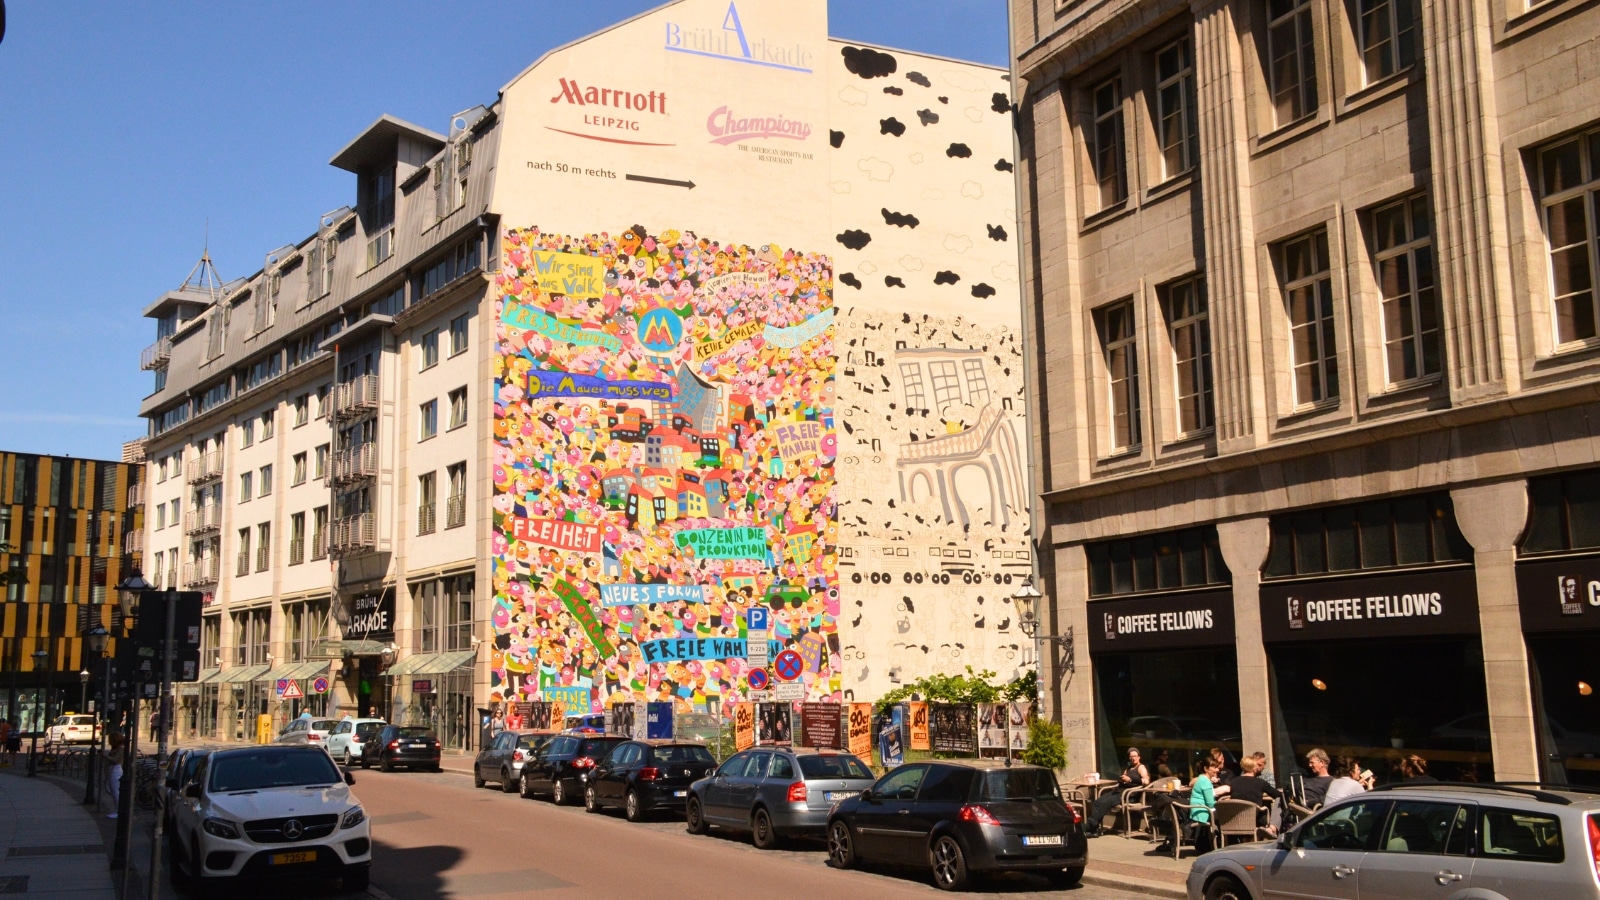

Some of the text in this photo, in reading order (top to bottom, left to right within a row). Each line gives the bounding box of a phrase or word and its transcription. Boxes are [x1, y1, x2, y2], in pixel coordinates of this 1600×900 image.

[665, 0, 813, 68] Brühl Arkade
[550, 77, 667, 115] Marriott
[584, 114, 640, 131] LEIPZIG
[707, 105, 811, 139] Champions
[737, 144, 749, 152] THE
[751, 146, 779, 156] AMERICAN
[780, 150, 801, 158] SPORTS
[759, 155, 793, 165] RESTAURANT
[527, 160, 617, 179] nach 50 m rechts
[534, 252, 564, 275] Wir
[540, 278, 558, 291] das
[696, 323, 757, 358] KEINE GEWALT
[529, 375, 670, 399] Die Mauer muss weg
[776, 423, 820, 444] FREIE
[513, 519, 598, 548] FREIHEIT
[677, 529, 763, 547] BONZEN IN DIE
[356, 594, 378, 610] BRÜHL
[603, 585, 701, 604] NEUES FORUM
[1306, 592, 1442, 622] COFFEE FELLOWS
[347, 611, 387, 633] ARKADE
[752, 611, 763, 627] P
[1117, 609, 1213, 634] COFFEE FELLOWS
[643, 639, 706, 662] FREIE
[545, 690, 588, 706] KEINE
